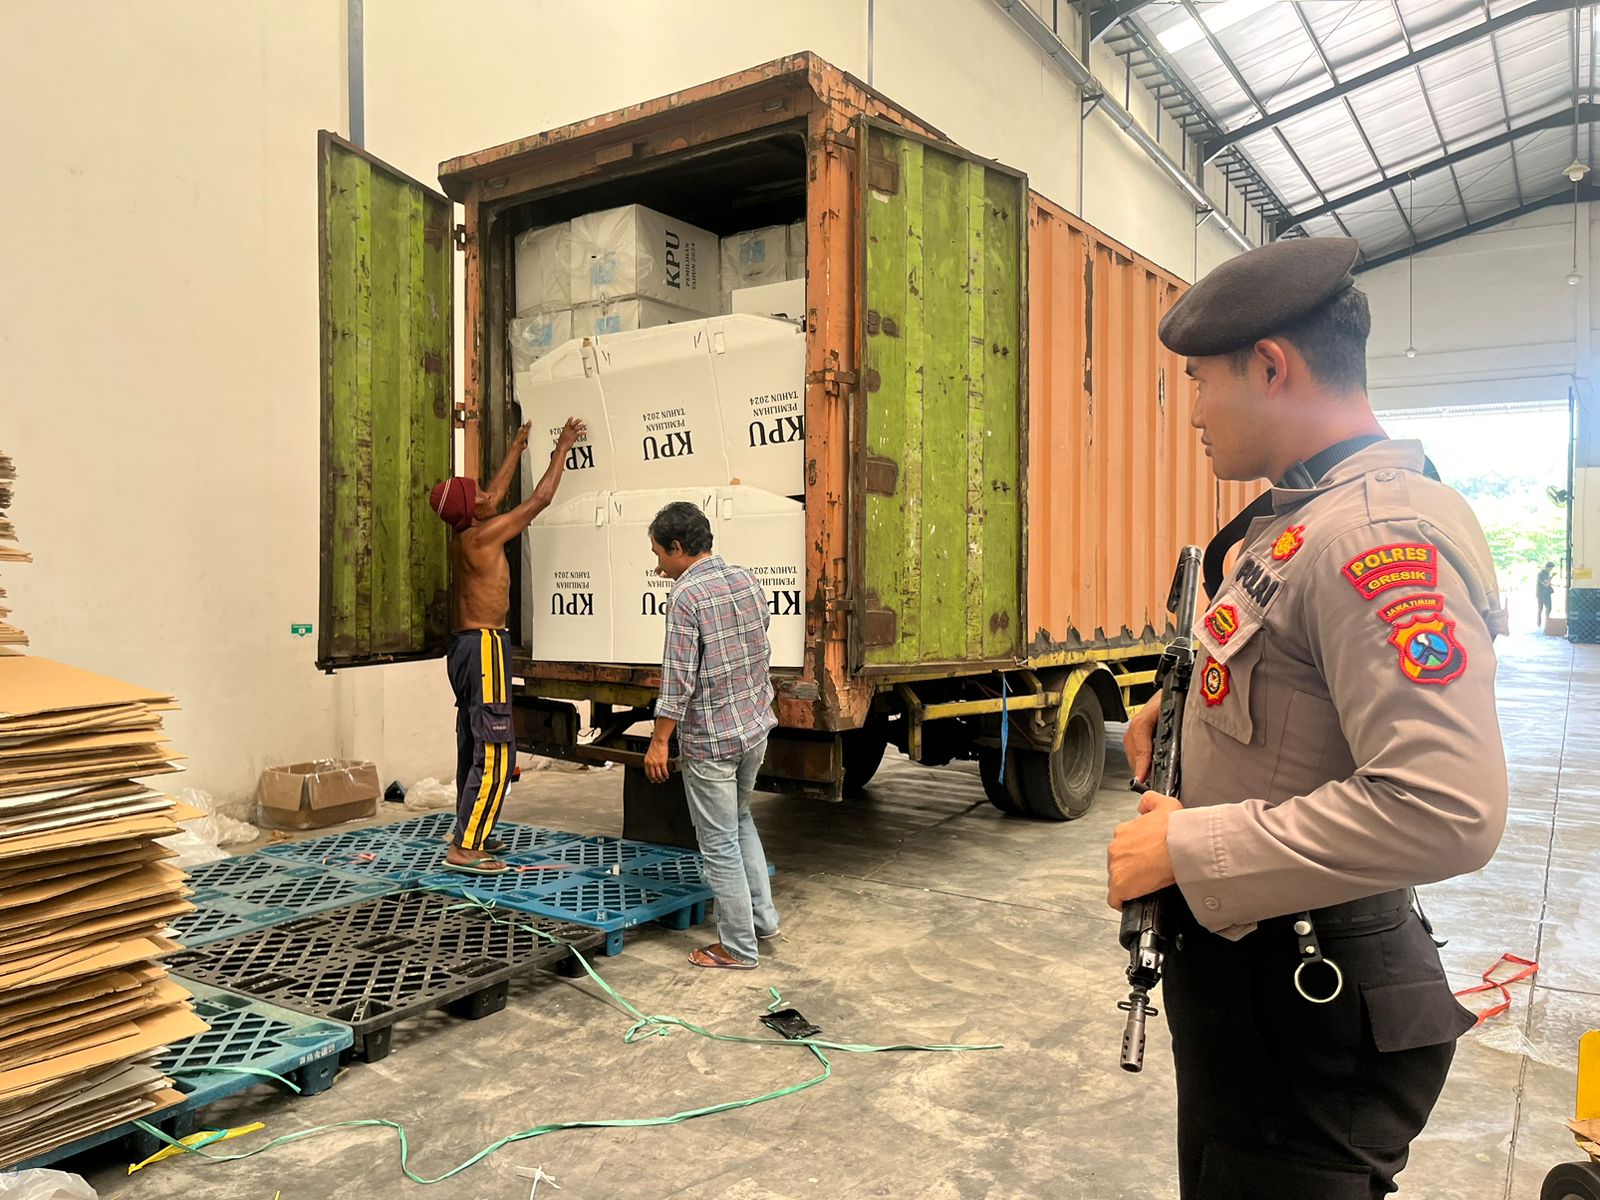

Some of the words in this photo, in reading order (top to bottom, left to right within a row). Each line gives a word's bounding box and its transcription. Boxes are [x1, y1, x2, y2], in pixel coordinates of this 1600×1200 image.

[665, 230, 681, 290] KPU
[750, 395, 769, 406] 2024
[771, 391, 798, 402] TAHUN
[643, 412, 660, 421] 2024
[661, 408, 685, 418] TAHUN
[753, 402, 798, 417] PEMILIHAN
[646, 419, 686, 432] PEMILIHAN
[749, 415, 804, 447] KPU
[643, 430, 694, 461] KPU
[550, 444, 595, 471] KP
[1350, 547, 1428, 577] POLRES
[554, 571, 569, 579] 2024
[570, 571, 591, 579] TAHUN
[770, 566, 797, 575] TAHUN
[556, 581, 590, 589] PEMILIHAN
[1368, 571, 1426, 590] GRESIK
[551, 592, 594, 616] KPU
[767, 590, 802, 616] KP
[1386, 602, 1409, 617] JAWA
[1409, 599, 1437, 609] TIMUR
